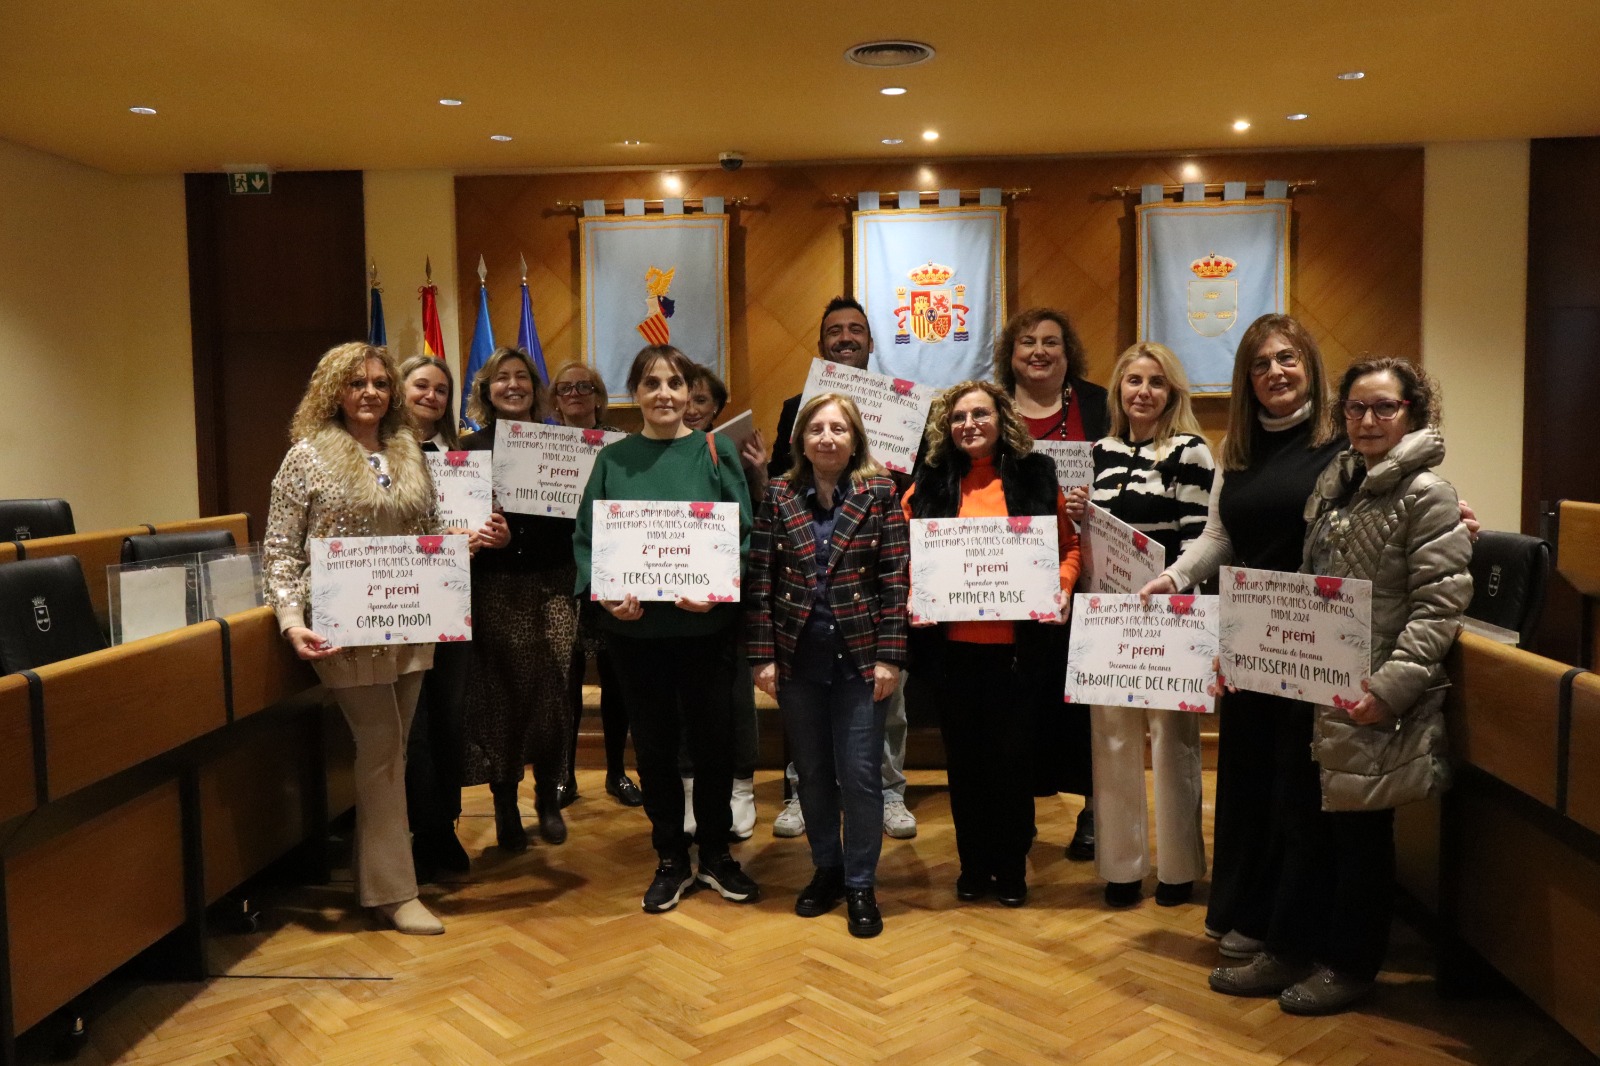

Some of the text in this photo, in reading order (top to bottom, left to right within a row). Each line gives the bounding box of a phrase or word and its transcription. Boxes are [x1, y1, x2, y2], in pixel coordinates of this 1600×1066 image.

[821, 370, 849, 381] CONCURS
[868, 400, 882, 409] 2024
[860, 411, 882, 423] remi
[508, 431, 537, 439] CONCURS
[507, 440, 543, 449] D'INTERIORS
[542, 452, 576, 462] NADAL 2024
[550, 467, 579, 478] premi
[1070, 471, 1086, 479] 2024
[606, 510, 639, 520] CONCURS
[606, 520, 648, 530] D'INTERIORS
[684, 521, 726, 532] COMERCIALS
[647, 531, 685, 540] NADAL 2024
[925, 527, 957, 538] CONCURS
[924, 537, 966, 549] D'INTERIORS
[1001, 537, 1045, 546] COMERCIALS
[327, 547, 362, 559] CONCURS
[642, 544, 691, 558] 2on premi
[965, 548, 1004, 558] NADAL 2024
[327, 559, 372, 570] D'INTERIORS
[411, 557, 457, 568] COMERCIALS
[644, 561, 673, 571] Aparador
[963, 562, 1008, 576] 1er premi
[372, 569, 414, 579] NADAL 2024
[1112, 564, 1132, 581] premi
[623, 572, 710, 585] TERESA CASINOS
[964, 580, 993, 589] Aparador
[1232, 581, 1263, 591] CONCURS
[367, 583, 419, 599] 2on premi
[948, 590, 1026, 604] PRIMERA BASE
[367, 602, 399, 612] Aparador
[1086, 604, 1118, 615] CONCURS
[1232, 594, 1271, 605] D'INTERIORS
[1308, 601, 1355, 618] COMERCIALS
[356, 613, 431, 629] GARBO MODA
[1270, 609, 1309, 622] NADAL 2024
[1084, 616, 1125, 626] D'INTERIORS
[1160, 617, 1205, 630] COMERCIALS
[1122, 628, 1161, 638] NADAL 2024
[1266, 624, 1315, 644] 2on premi
[1117, 643, 1165, 659] 3er premi
[1290, 648, 1297, 657] de
[1138, 662, 1146, 670] de
[1235, 653, 1350, 687] PASTISSERIA LA PALMA
[1076, 671, 1204, 694] LA BOUTIQUE DEL RETALL
